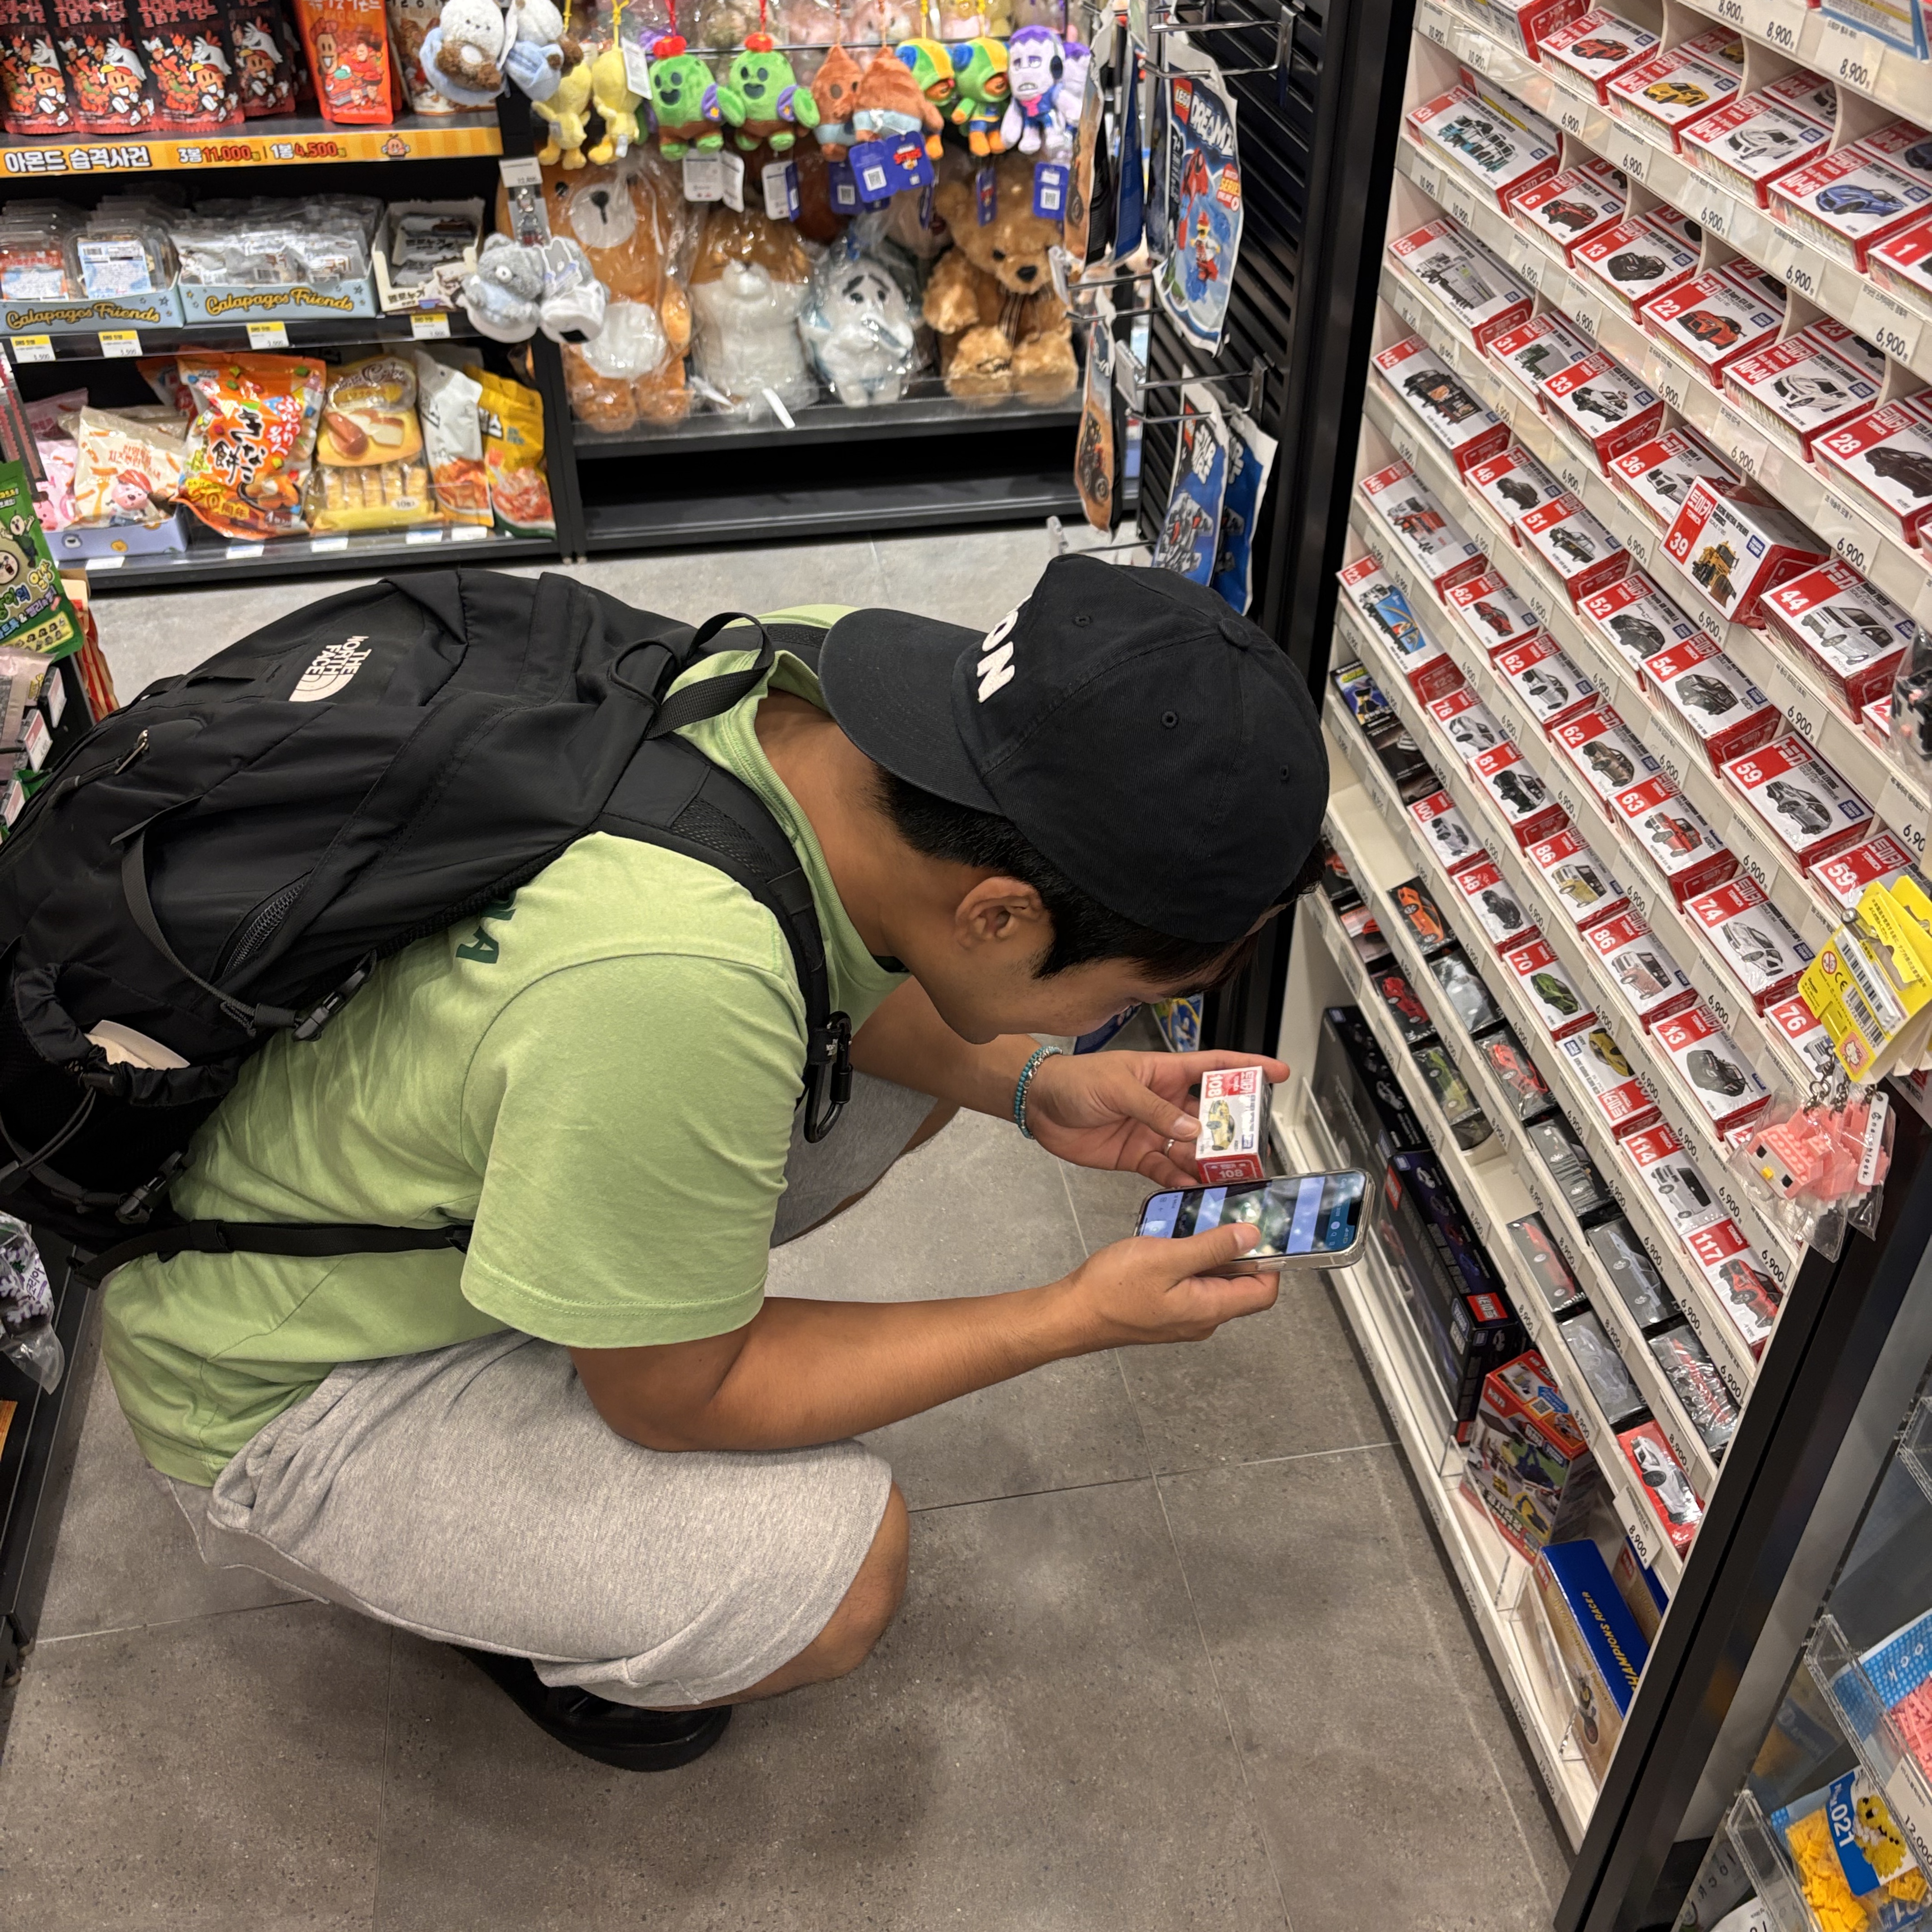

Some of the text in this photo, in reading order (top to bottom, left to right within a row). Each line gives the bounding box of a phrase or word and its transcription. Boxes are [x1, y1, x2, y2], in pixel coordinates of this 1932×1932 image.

[4, 151, 67, 173] 아몬드
[70, 146, 152, 170] 습격사건
[1526, 194, 1540, 205] 6
[1586, 243, 1606, 258] 13
[1894, 244, 1918, 258] 1
[206, 288, 354, 316] Galapagos Friends
[1653, 299, 1681, 318] 22
[6, 302, 161, 330] Galapagos Friends
[1496, 338, 1516, 352] 31
[1551, 377, 1571, 392] 33
[1828, 433, 1862, 453] 28
[1476, 467, 1495, 482] 48
[1621, 456, 1645, 473] 36
[1526, 513, 1547, 528] 51
[1670, 532, 1688, 557] 39
[1821, 562, 1858, 589] トミカ
[1589, 597, 1613, 616] 52
[1780, 589, 1809, 612] 44
[305, 644, 342, 674] FACE
[322, 636, 369, 674] NORTH
[340, 649, 372, 674] THE
[1504, 655, 1524, 671] 62
[1652, 656, 1678, 676] 54
[1436, 701, 1454, 717] 78
[1563, 726, 1585, 744] 62
[1479, 754, 1500, 772] 81
[1736, 761, 1763, 783] 59
[1414, 801, 1434, 820] 100
[1621, 792, 1645, 812] 63
[1536, 844, 1556, 863] 86
[1463, 874, 1480, 890] 48
[1827, 862, 1858, 887] 59
[1697, 899, 1724, 921] 74
[1593, 928, 1616, 949] 86
[1513, 952, 1533, 971] 70
[1835, 971, 1849, 991] CE
[1778, 1005, 1807, 1031] 76
[1208, 1075, 1224, 1097] 108
[1630, 1136, 1658, 1162] 114
[1219, 1169, 1243, 1178] 108
[1694, 1233, 1725, 1260] 117
[1582, 1591, 1607, 1624] RACER
[1600, 1622, 1640, 1692] HAMPIONS
[1831, 1803, 1855, 1848] 021
